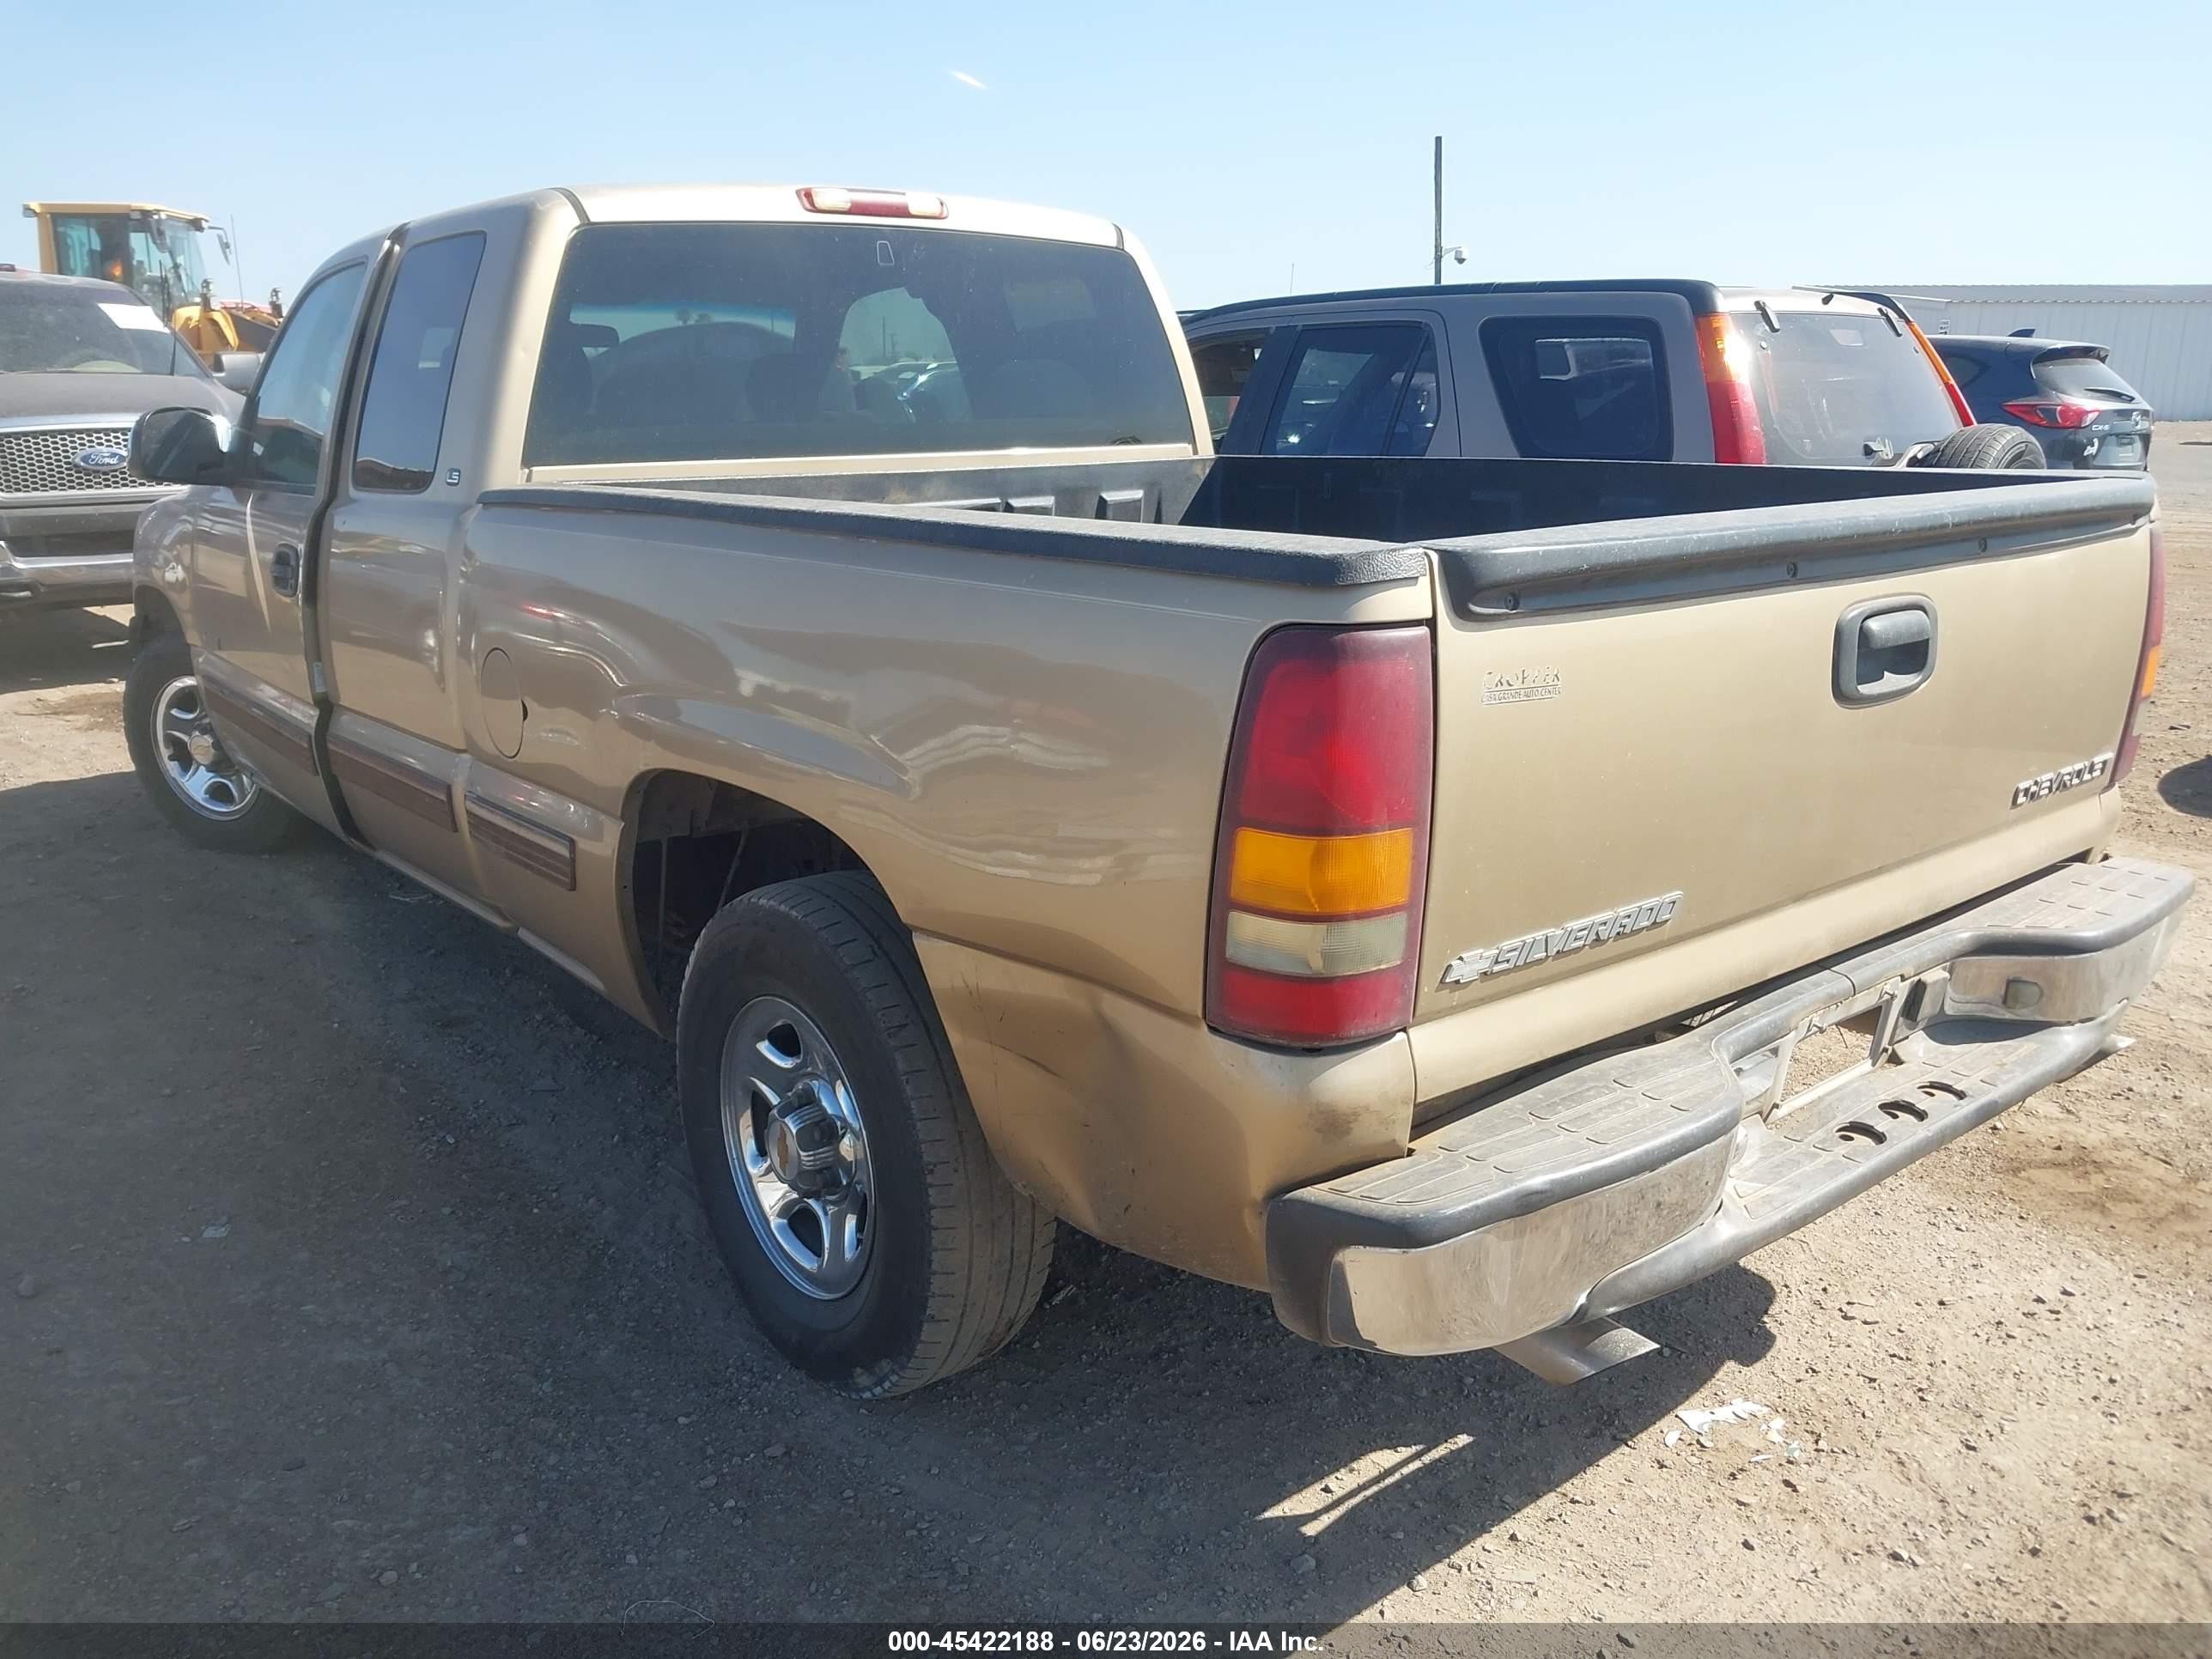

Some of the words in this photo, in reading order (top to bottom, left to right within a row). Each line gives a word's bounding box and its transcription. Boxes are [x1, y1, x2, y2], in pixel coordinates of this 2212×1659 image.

[88, 453, 120, 465] Ford
[447, 471, 459, 483] LS
[1498, 690, 1522, 702] GRANDE
[1523, 689, 1540, 699] AUTO
[1540, 686, 1561, 697] CENTER
[2010, 752, 2115, 807] CHEVROLET
[1488, 891, 1683, 975] SILVERADO
